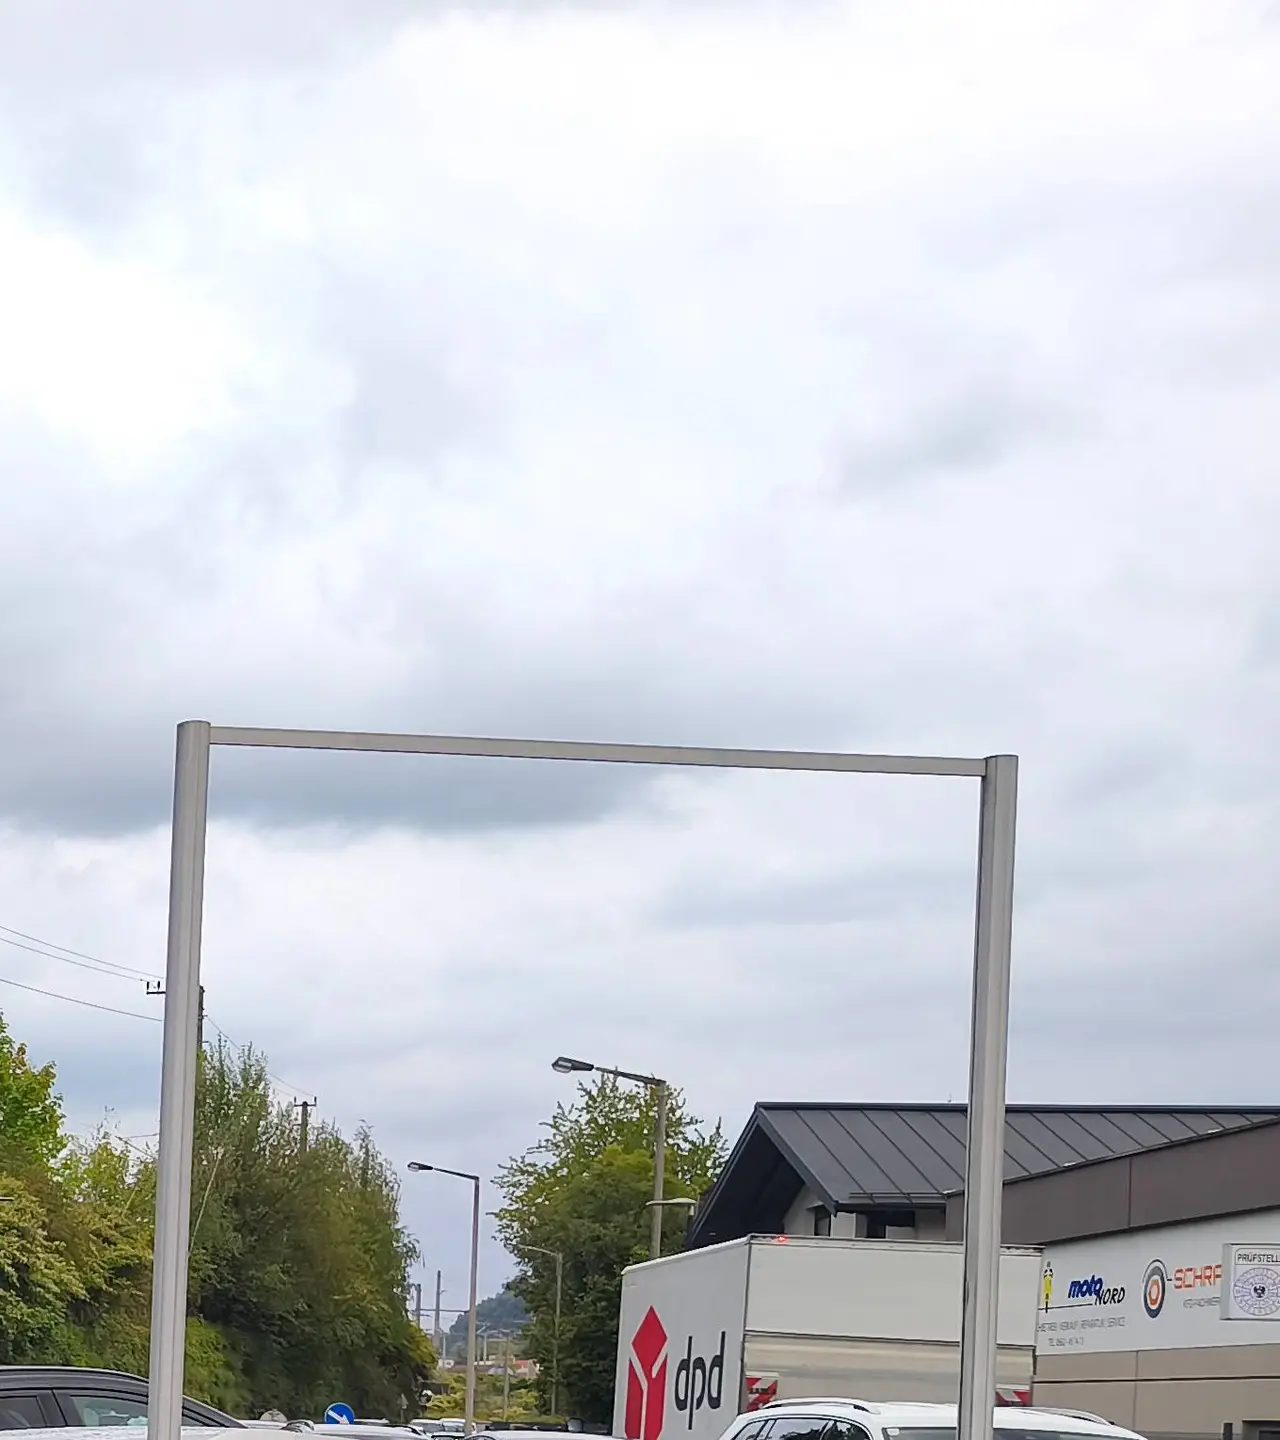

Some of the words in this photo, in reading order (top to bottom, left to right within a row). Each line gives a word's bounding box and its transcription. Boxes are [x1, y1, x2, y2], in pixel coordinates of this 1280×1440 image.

[1068, 1275, 1103, 1298] moto
[1095, 1287, 1126, 1305] NORD
[674, 1331, 726, 1430] dpd
